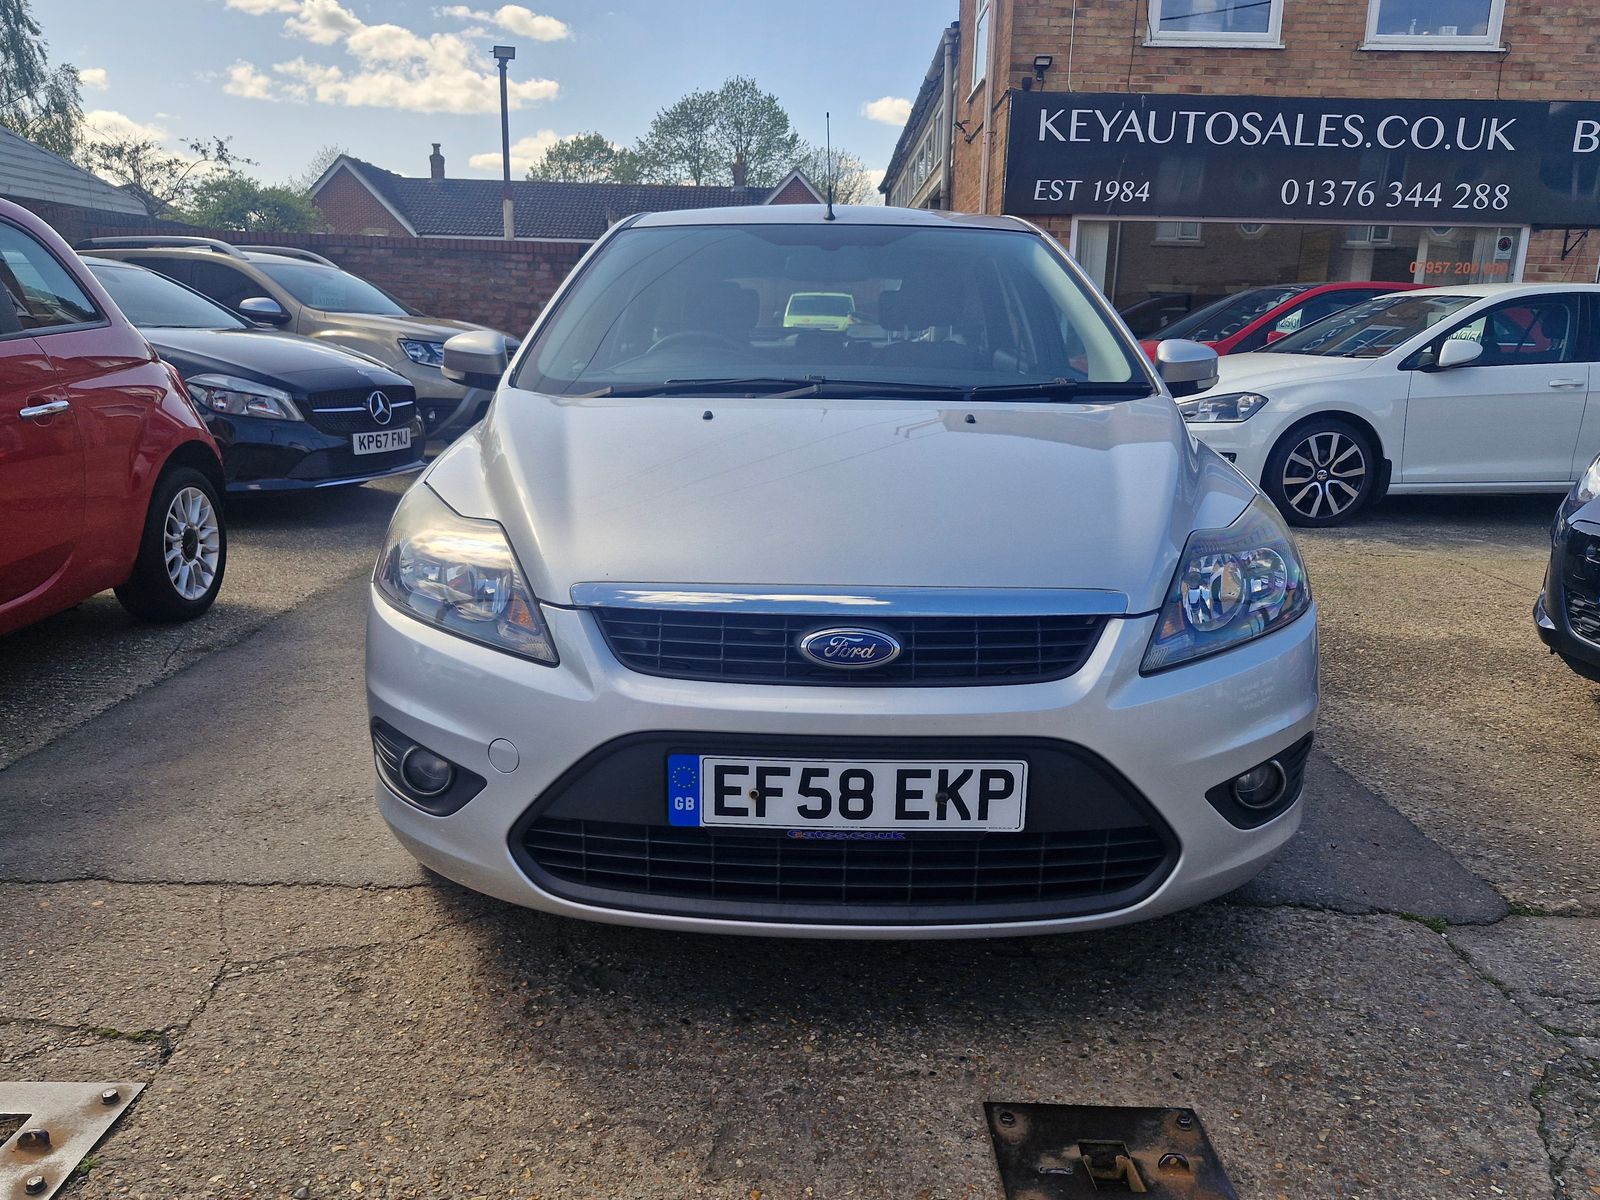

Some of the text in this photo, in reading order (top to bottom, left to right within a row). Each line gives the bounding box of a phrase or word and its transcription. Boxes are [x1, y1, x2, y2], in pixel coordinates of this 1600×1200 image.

[1038, 108, 1517, 151] KEYAUTOSALES.CO.UK
[1033, 179, 1150, 202] EST 1984
[1280, 179, 1510, 210] 01376 344 288
[1409, 261, 1451, 273] 07957
[358, 430, 408, 450] KP67 FNJ
[824, 636, 876, 659] Ford
[674, 797, 695, 811] GB
[714, 764, 1015, 821] EF58 EKP
